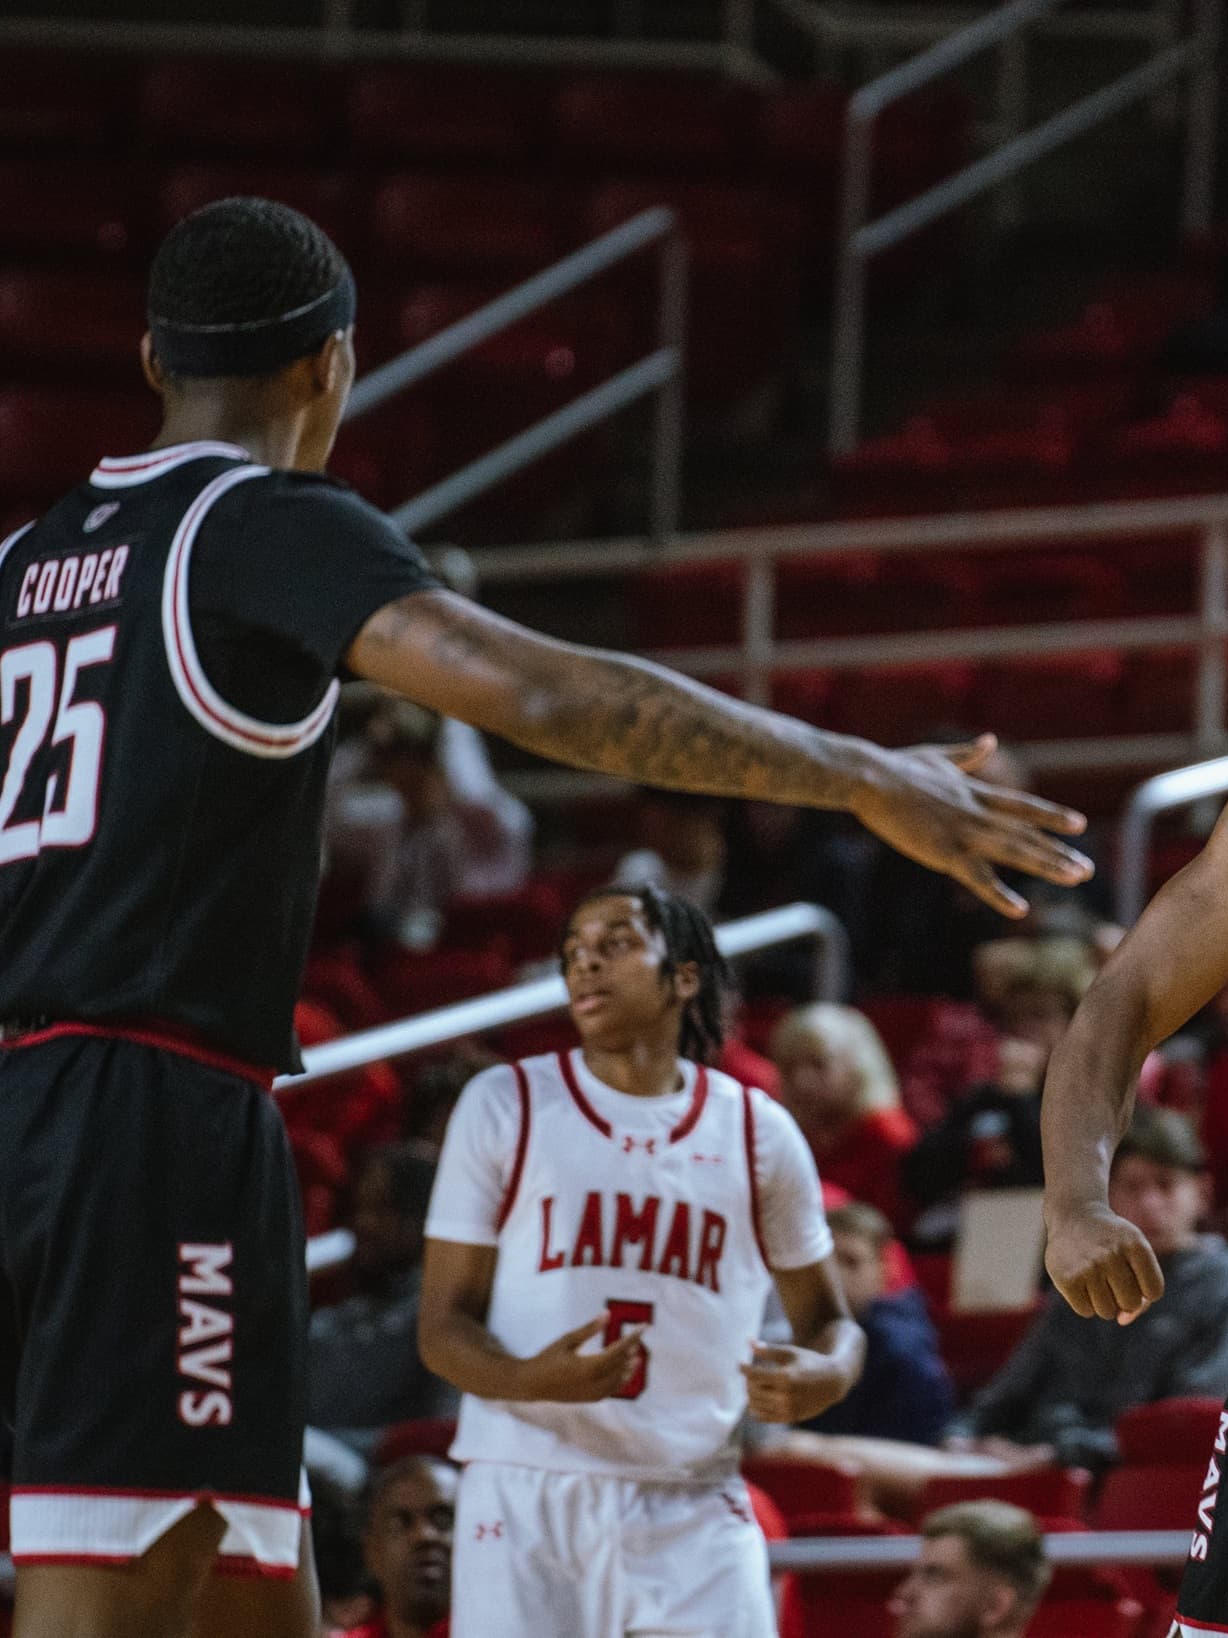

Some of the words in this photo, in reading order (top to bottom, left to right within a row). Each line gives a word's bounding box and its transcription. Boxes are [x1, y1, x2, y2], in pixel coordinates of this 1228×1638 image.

[17, 545, 129, 617] COOPER
[0, 626, 116, 864] 25
[538, 1190, 727, 1292] LAMAR
[177, 1242, 232, 1426] MAVS
[603, 1299, 653, 1399] 5
